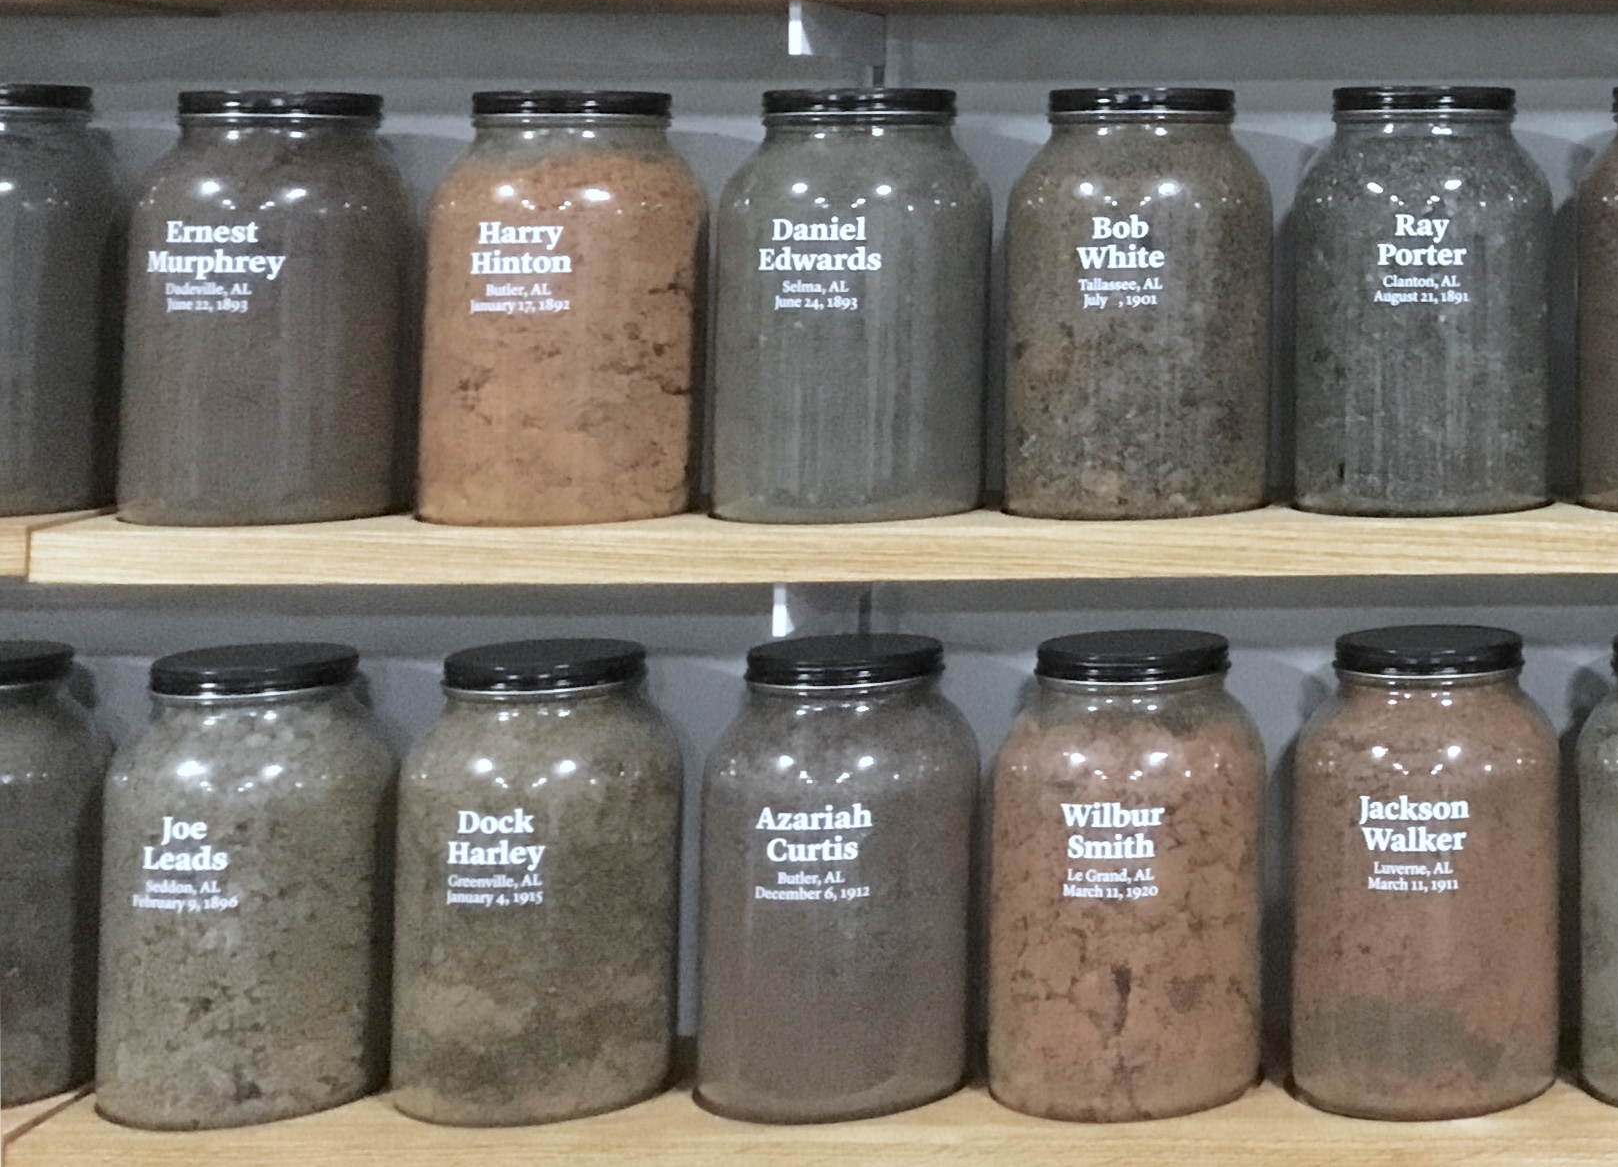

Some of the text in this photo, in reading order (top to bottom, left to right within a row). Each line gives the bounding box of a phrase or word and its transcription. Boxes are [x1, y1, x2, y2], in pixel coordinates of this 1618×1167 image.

[166, 221, 259, 243] Ernest
[478, 222, 564, 250] Harry
[772, 217, 866, 241] Daniel
[1092, 215, 1149, 239] Bob
[1395, 213, 1449, 243] Ray
[147, 249, 285, 280] Murphrey
[470, 251, 572, 274] Hinton
[759, 246, 881, 271] Edwards
[1076, 244, 1165, 269] White
[1377, 243, 1466, 266] Porter
[486, 283, 551, 297] Butler, AL
[782, 280, 849, 294] Selma, AL
[1078, 278, 1162, 292] Tallassee, AL
[1382, 276, 1460, 289] Clanton, AL
[470, 299, 570, 313] January 17, 1892
[775, 296, 858, 310] June 24, 1893
[1374, 291, 1469, 305] August 21, 1891
[457, 809, 534, 834] Dock
[755, 803, 872, 830] Azariah
[1061, 802, 1165, 828] Wilbur
[1359, 795, 1469, 825] Jackson
[161, 816, 207, 845] Joe
[1362, 826, 1467, 852] Walker
[448, 839, 545, 871] Harley
[767, 835, 859, 862] Curtis
[1067, 833, 1155, 859] Smith
[143, 846, 227, 871] Leads
[1374, 862, 1453, 876] Luverne, AL
[777, 872, 845, 886] Butler, AL
[1067, 869, 1155, 883] Le Grand, AL
[1368, 877, 1458, 892] March 11, 1911
[755, 887, 870, 901] December 6, 1912
